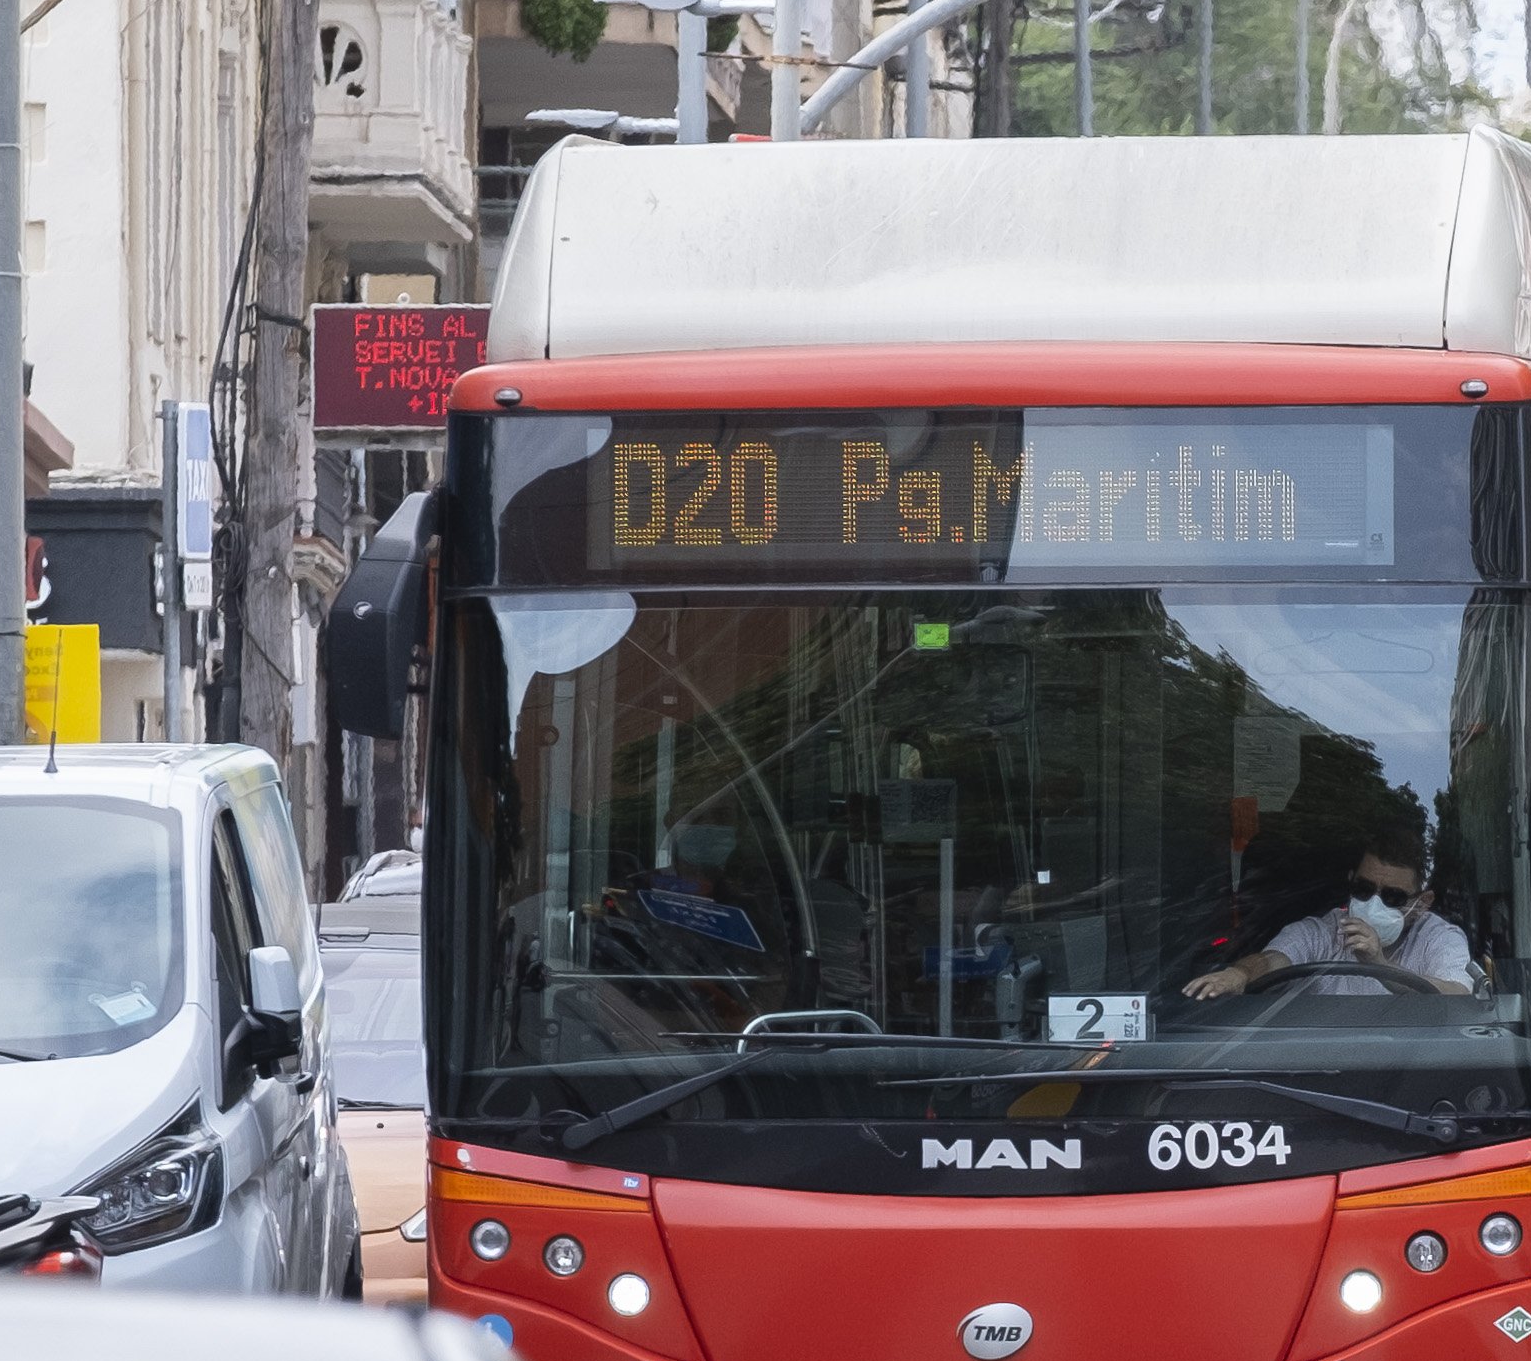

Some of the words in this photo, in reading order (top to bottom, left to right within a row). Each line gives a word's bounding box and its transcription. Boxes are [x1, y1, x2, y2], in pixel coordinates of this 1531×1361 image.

[354, 313, 425, 338] FINS
[442, 314, 477, 338] AL
[355, 340, 457, 364] SERVEI
[614, 442, 778, 546] D20
[1075, 998, 1106, 1040] 2
[922, 1138, 1082, 1170] MAN
[1147, 1121, 1292, 1171] 6034
[973, 1325, 1023, 1342] TMB
